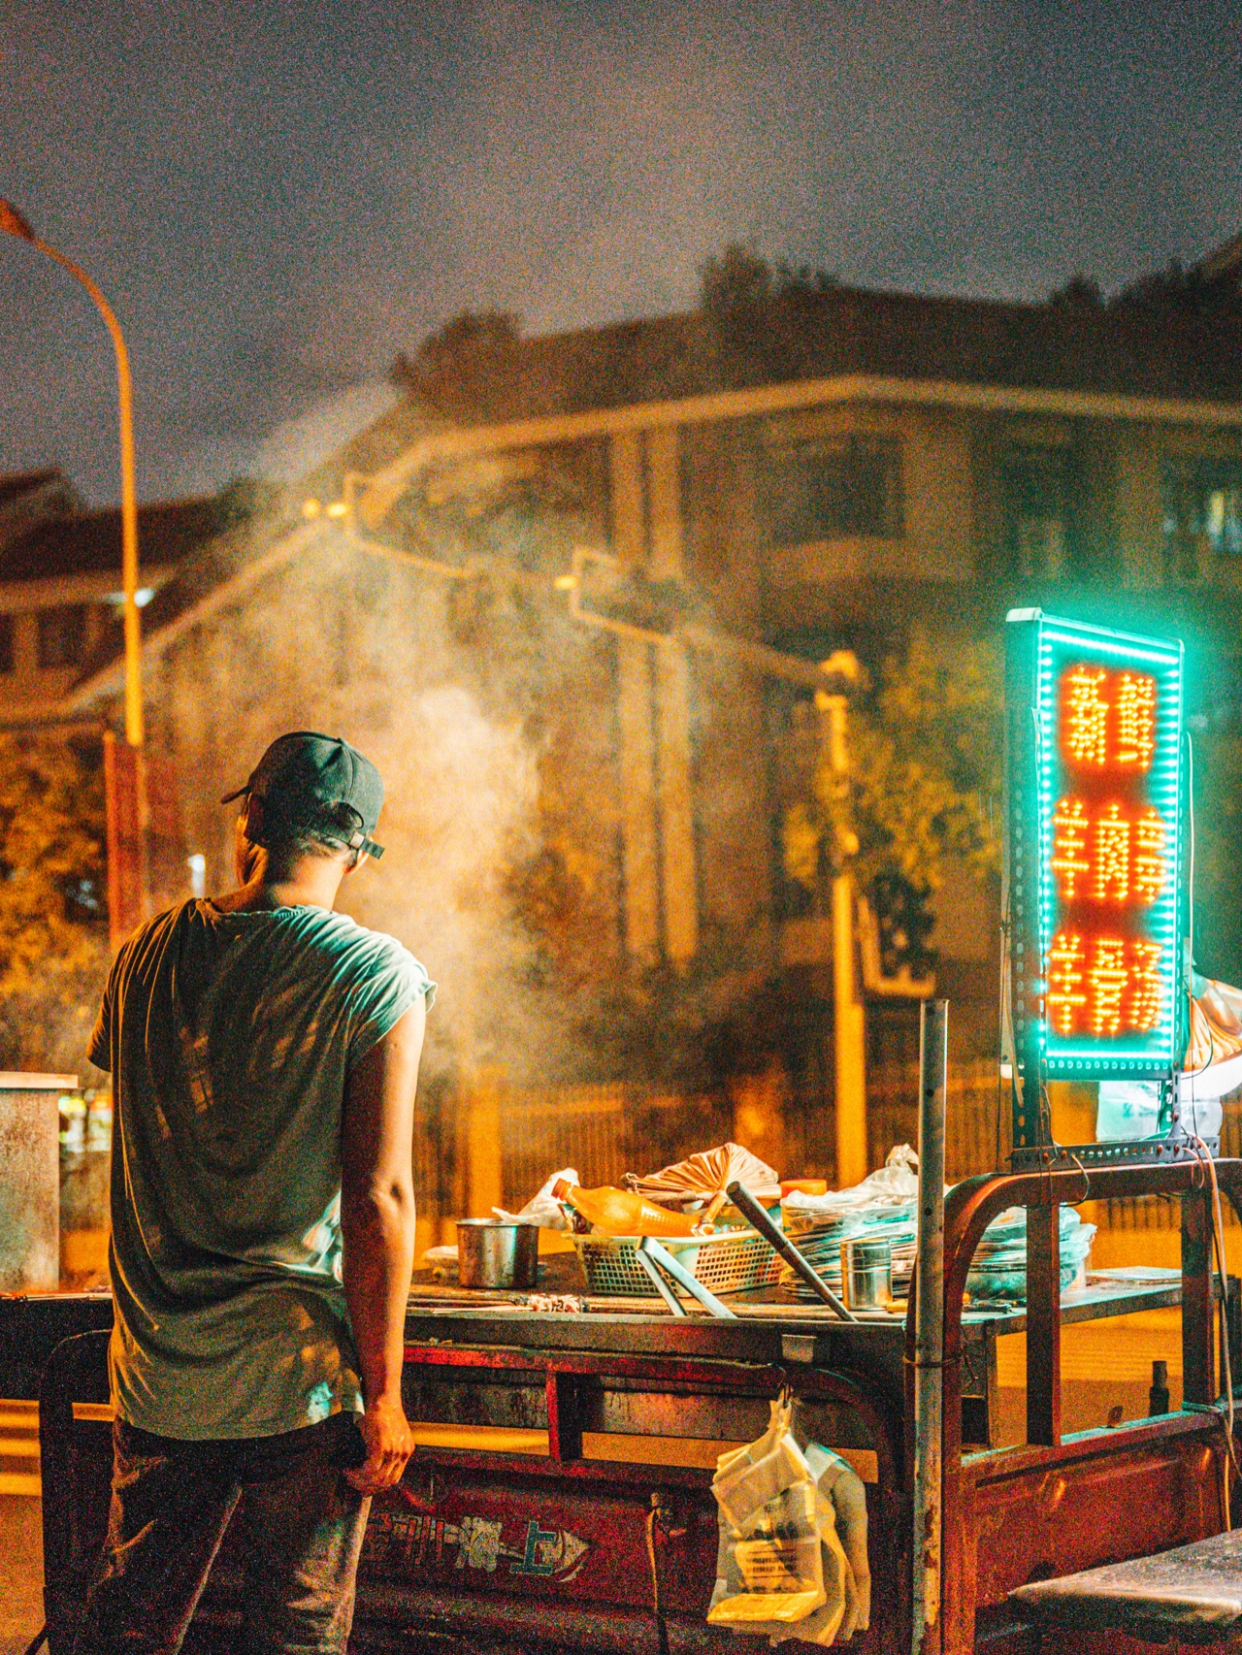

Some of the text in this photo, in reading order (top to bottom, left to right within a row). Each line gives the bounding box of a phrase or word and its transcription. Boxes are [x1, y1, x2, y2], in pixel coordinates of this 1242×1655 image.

[1067, 665, 1155, 772] 新鲜
[1051, 799, 1167, 904] 羊肉串
[1047, 933, 1163, 1035] 羊骨汤
